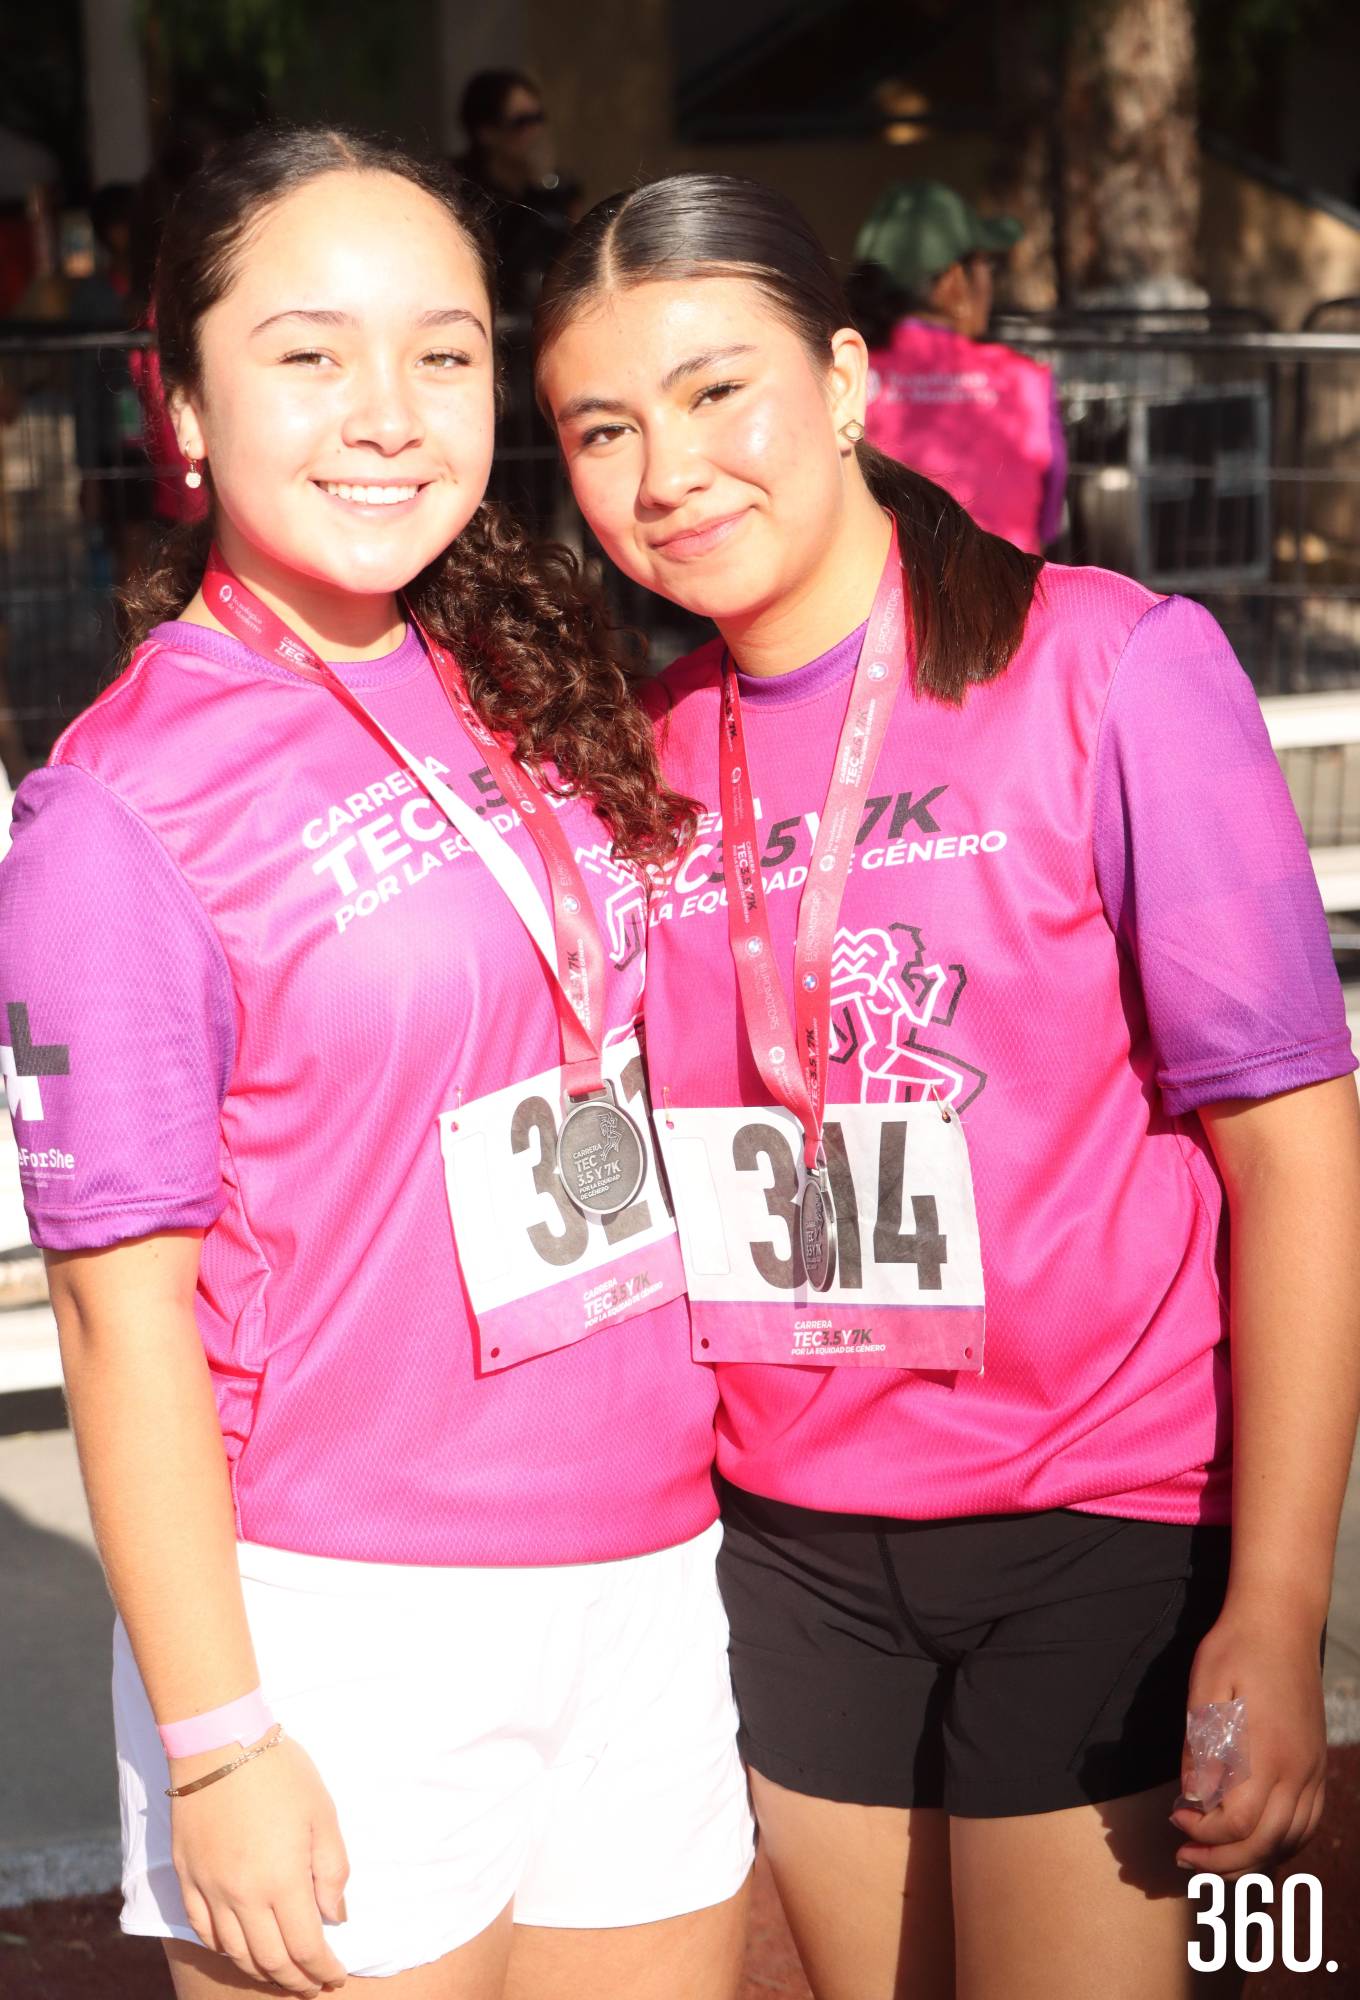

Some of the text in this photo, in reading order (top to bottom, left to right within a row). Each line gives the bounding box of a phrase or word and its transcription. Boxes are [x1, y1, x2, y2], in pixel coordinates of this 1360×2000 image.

[301, 755, 450, 850] CARREA
[862, 829, 1008, 871] GÉNERO
[334, 875, 402, 934] POR
[404, 852, 443, 886] LA
[19, 1148, 75, 1169] eForShe
[573, 1144, 602, 1159] CARRERA
[575, 1155, 597, 1173] TEC
[604, 1160, 621, 1176] 7K
[733, 1121, 947, 1290] 314
[794, 1319, 833, 1330] CARRERA
[791, 1348, 805, 1356] POR
[816, 1346, 845, 1356] EQUIDAD
[846, 1345, 855, 1353] DE
